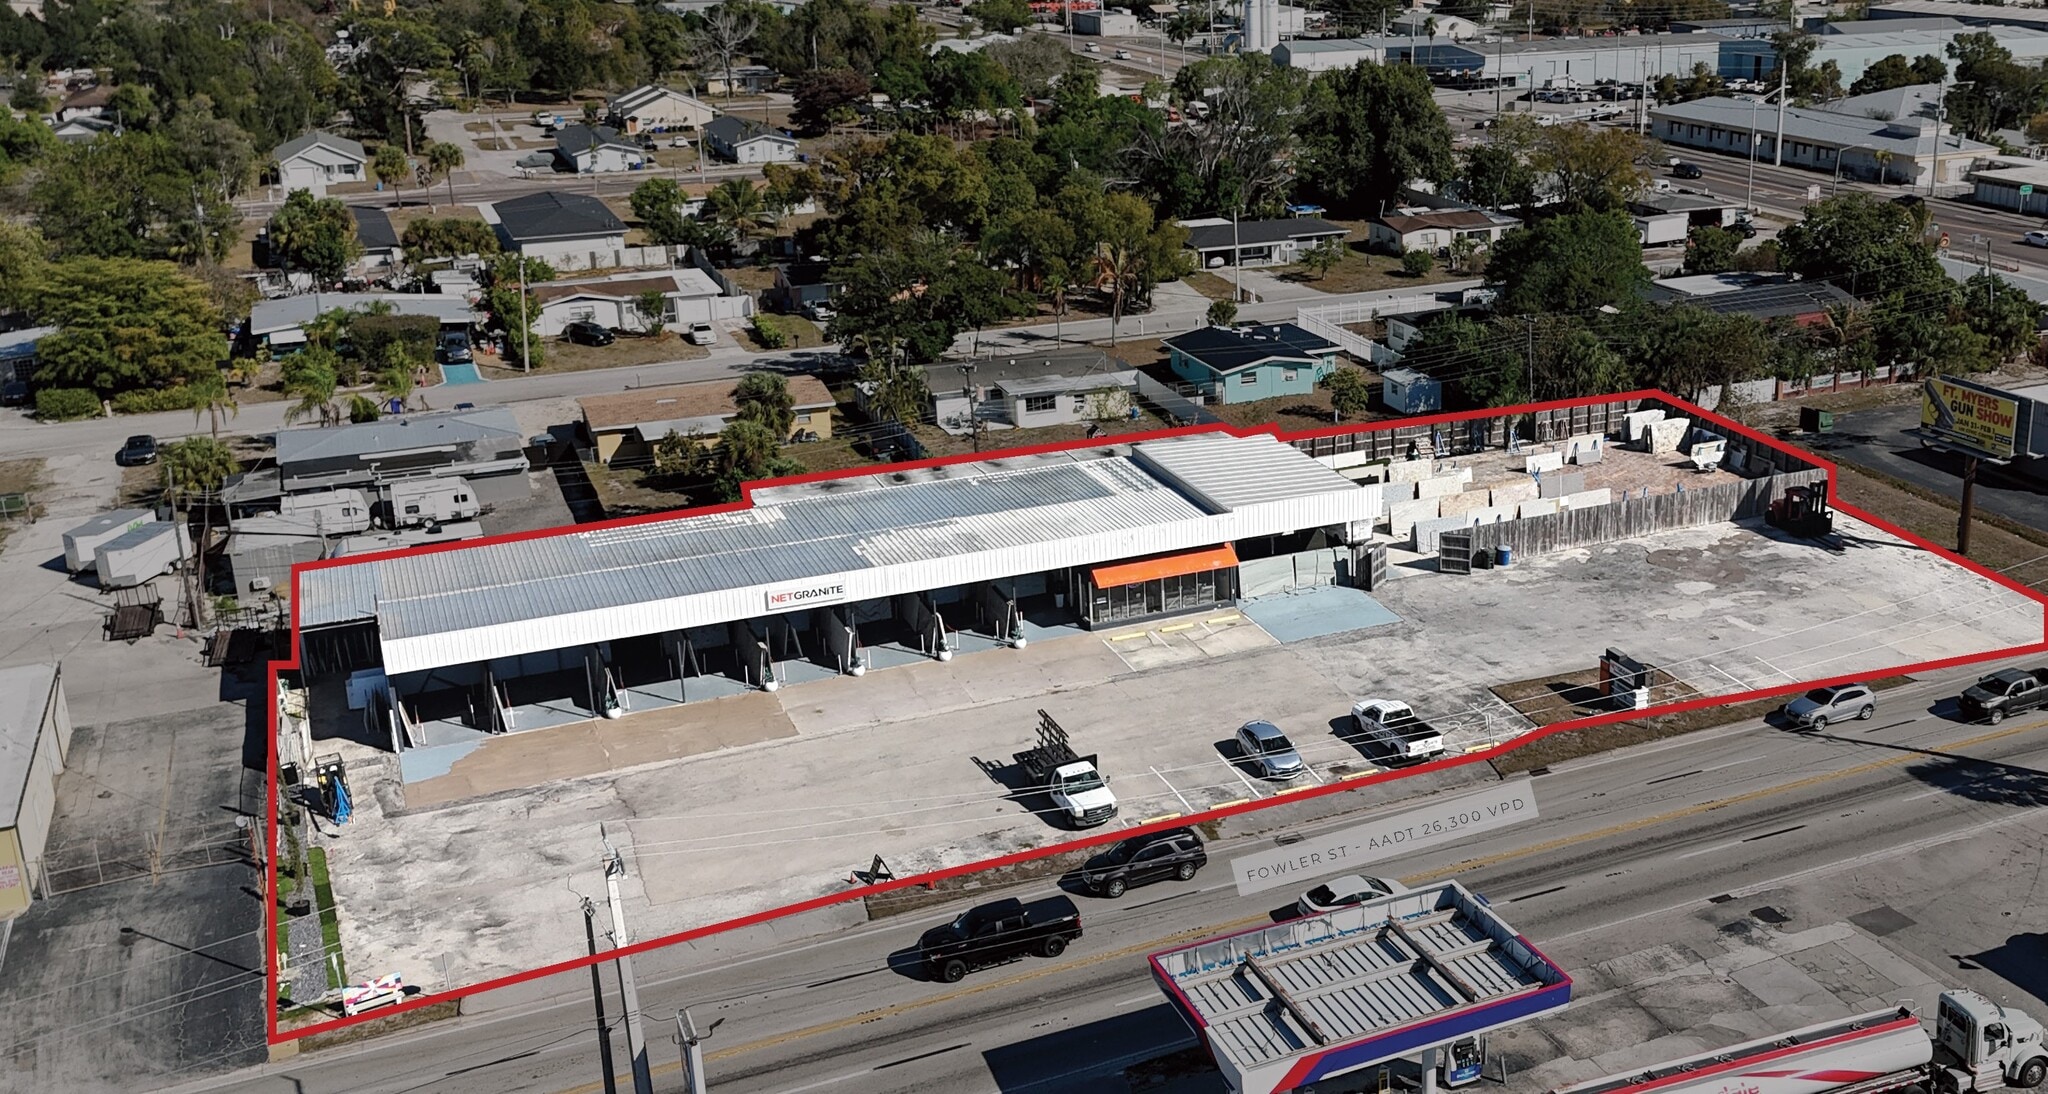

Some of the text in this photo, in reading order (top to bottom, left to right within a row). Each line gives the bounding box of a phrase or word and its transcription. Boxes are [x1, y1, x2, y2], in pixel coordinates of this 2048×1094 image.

[1942, 384, 2000, 411] FT. MYERS
[1950, 400, 2013, 428] GUN SHOW
[771, 585, 844, 603] NETGRANITE
